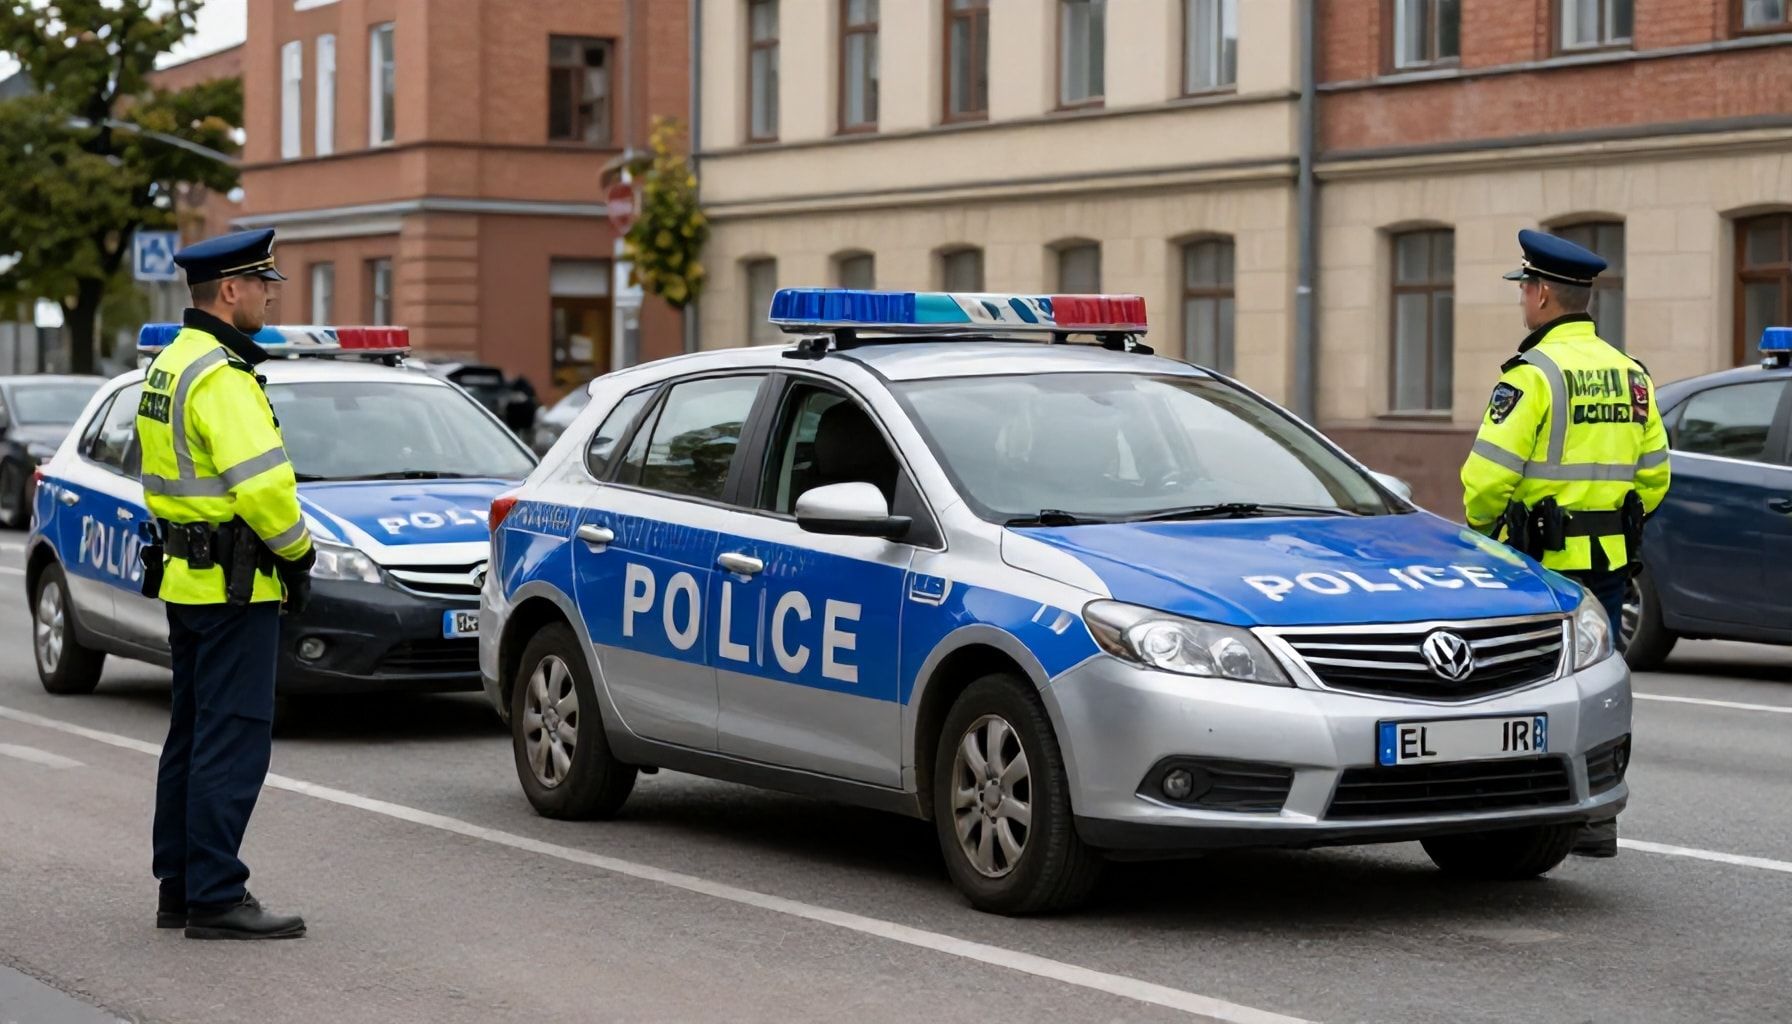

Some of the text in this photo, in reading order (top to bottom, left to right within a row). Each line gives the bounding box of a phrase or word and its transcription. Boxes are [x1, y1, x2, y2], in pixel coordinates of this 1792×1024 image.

[1241, 564, 1509, 602] POLICE
[622, 561, 862, 684] POLICE
[1400, 726, 1438, 760] EL
